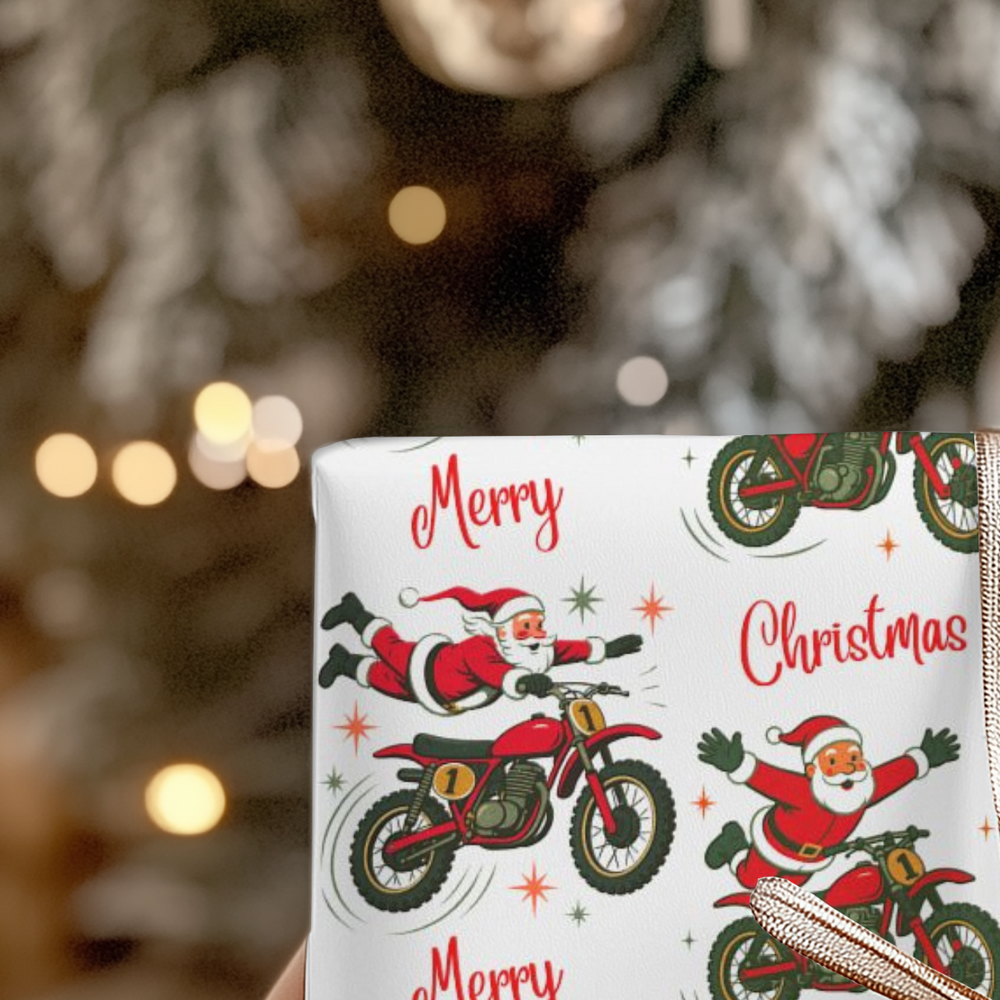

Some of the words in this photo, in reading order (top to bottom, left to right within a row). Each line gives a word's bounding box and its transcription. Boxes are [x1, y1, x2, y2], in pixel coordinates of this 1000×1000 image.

[411, 453, 564, 553] Merry
[740, 594, 968, 687] Christmas
[579, 704, 596, 732] 1
[446, 767, 459, 795] 1
[897, 852, 919, 880] 1
